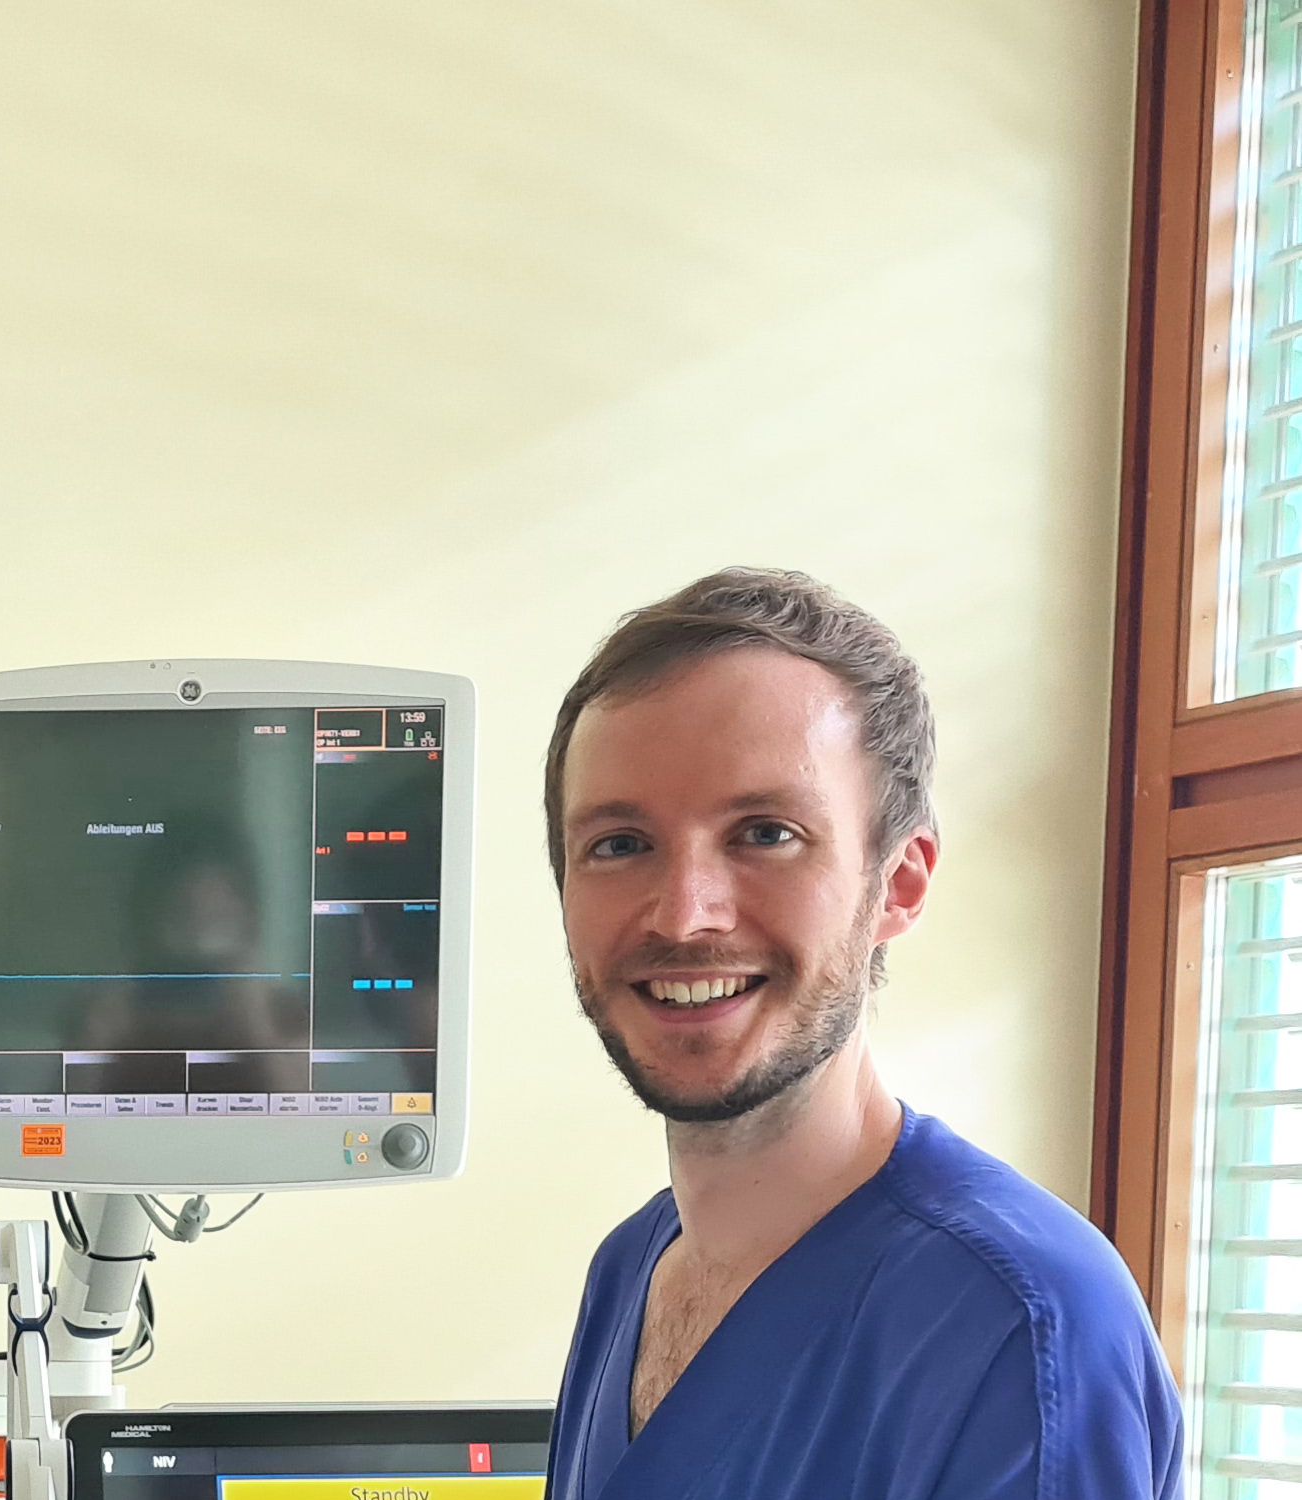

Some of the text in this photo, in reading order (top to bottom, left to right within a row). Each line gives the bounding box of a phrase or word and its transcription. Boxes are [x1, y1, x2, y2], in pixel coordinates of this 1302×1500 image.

[400, 712, 426, 723] 13:59
[86, 823, 164, 836] Ableitungen AUS
[38, 1137, 62, 1145] 2023
[153, 1456, 176, 1468] NIV
